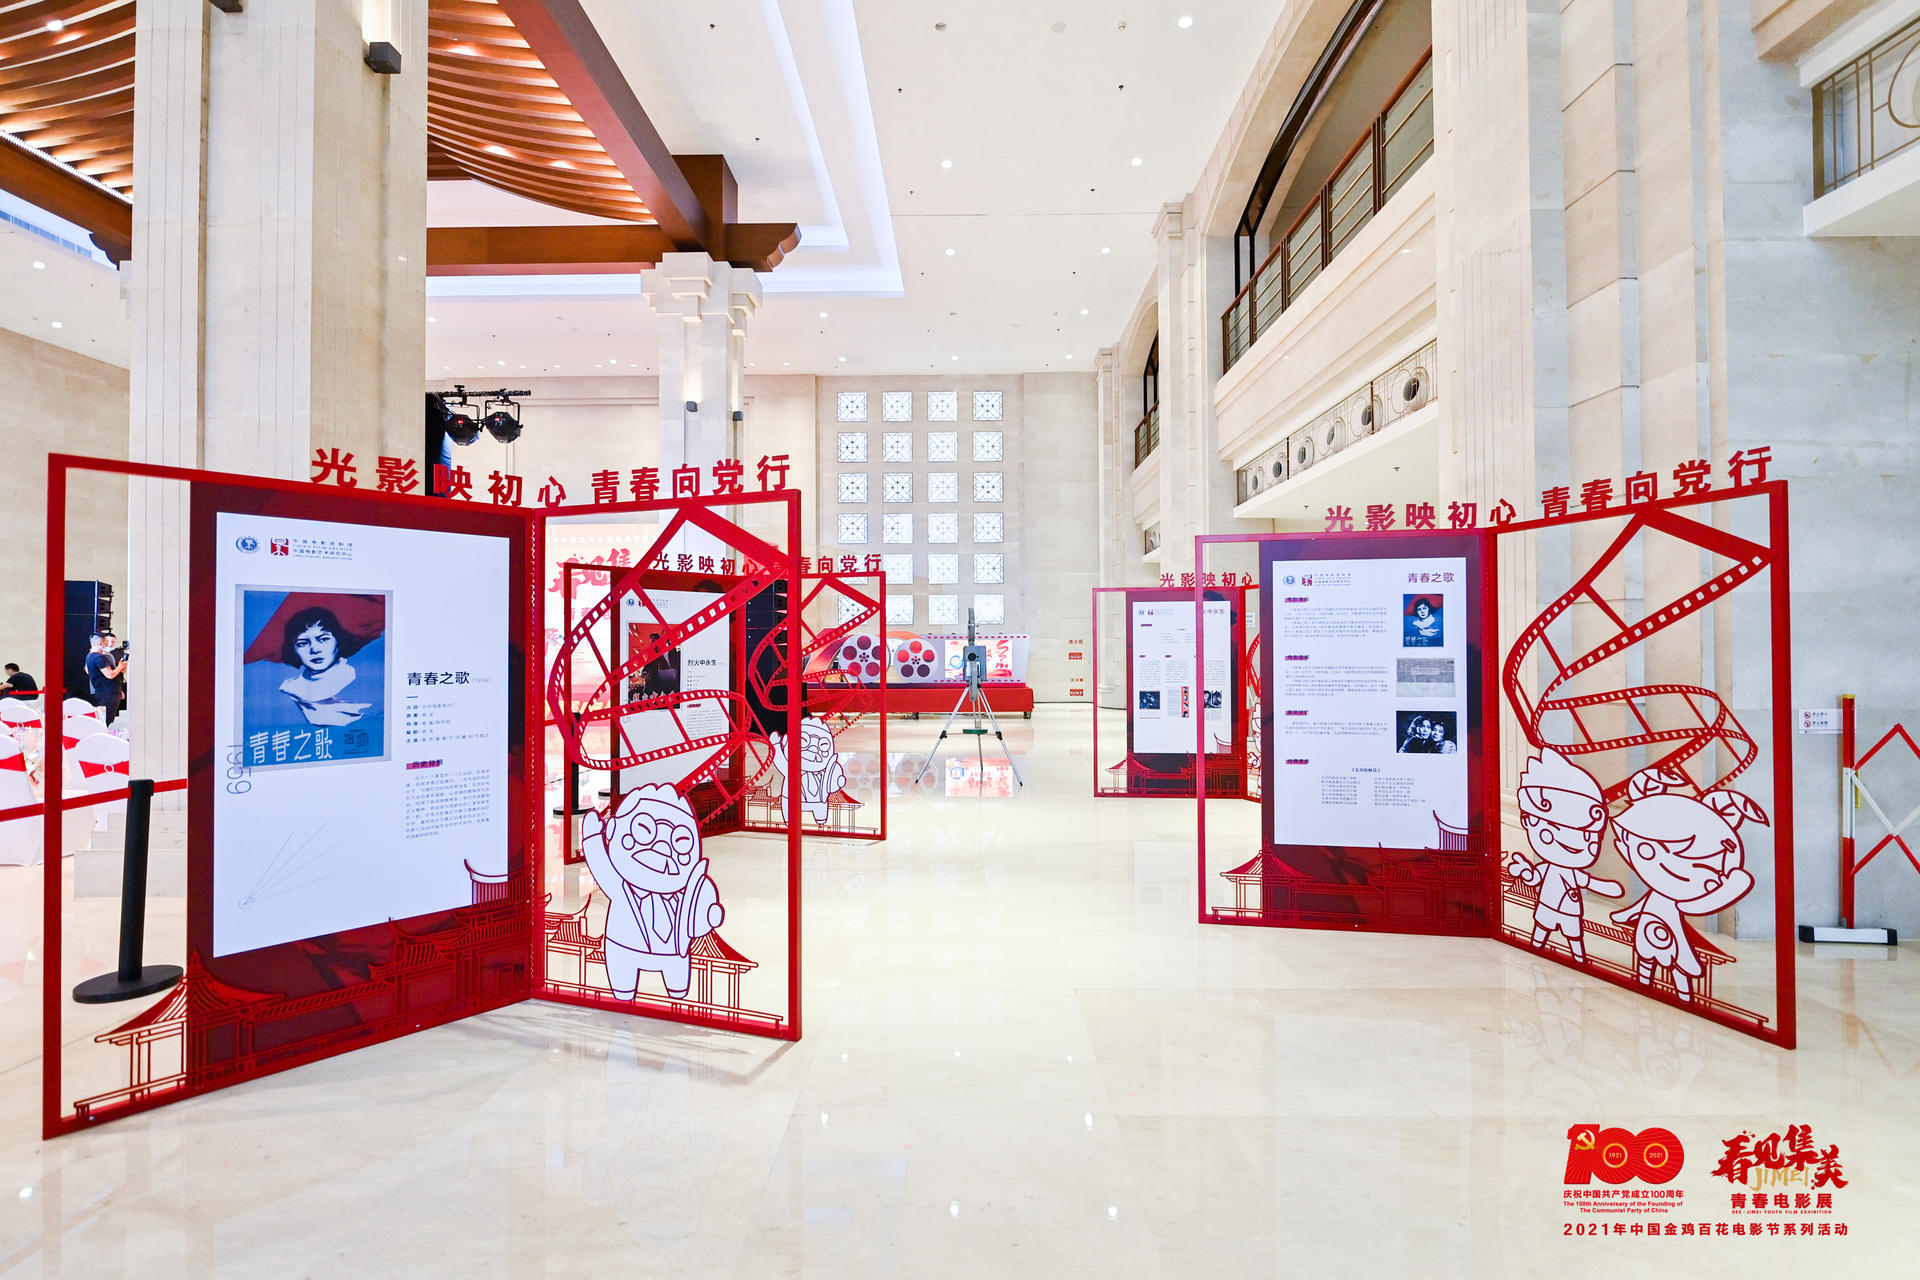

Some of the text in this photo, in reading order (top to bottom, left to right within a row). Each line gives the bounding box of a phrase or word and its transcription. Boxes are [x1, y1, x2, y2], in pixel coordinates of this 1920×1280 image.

[311, 448, 790, 507] 光影映初心 青春向党行
[1324, 446, 1771, 533] 光影映初心 青春向党行
[1408, 572, 1455, 583] 青春之歌
[407, 671, 470, 686] 青春之歌
[249, 727, 333, 764] 青春之歌
